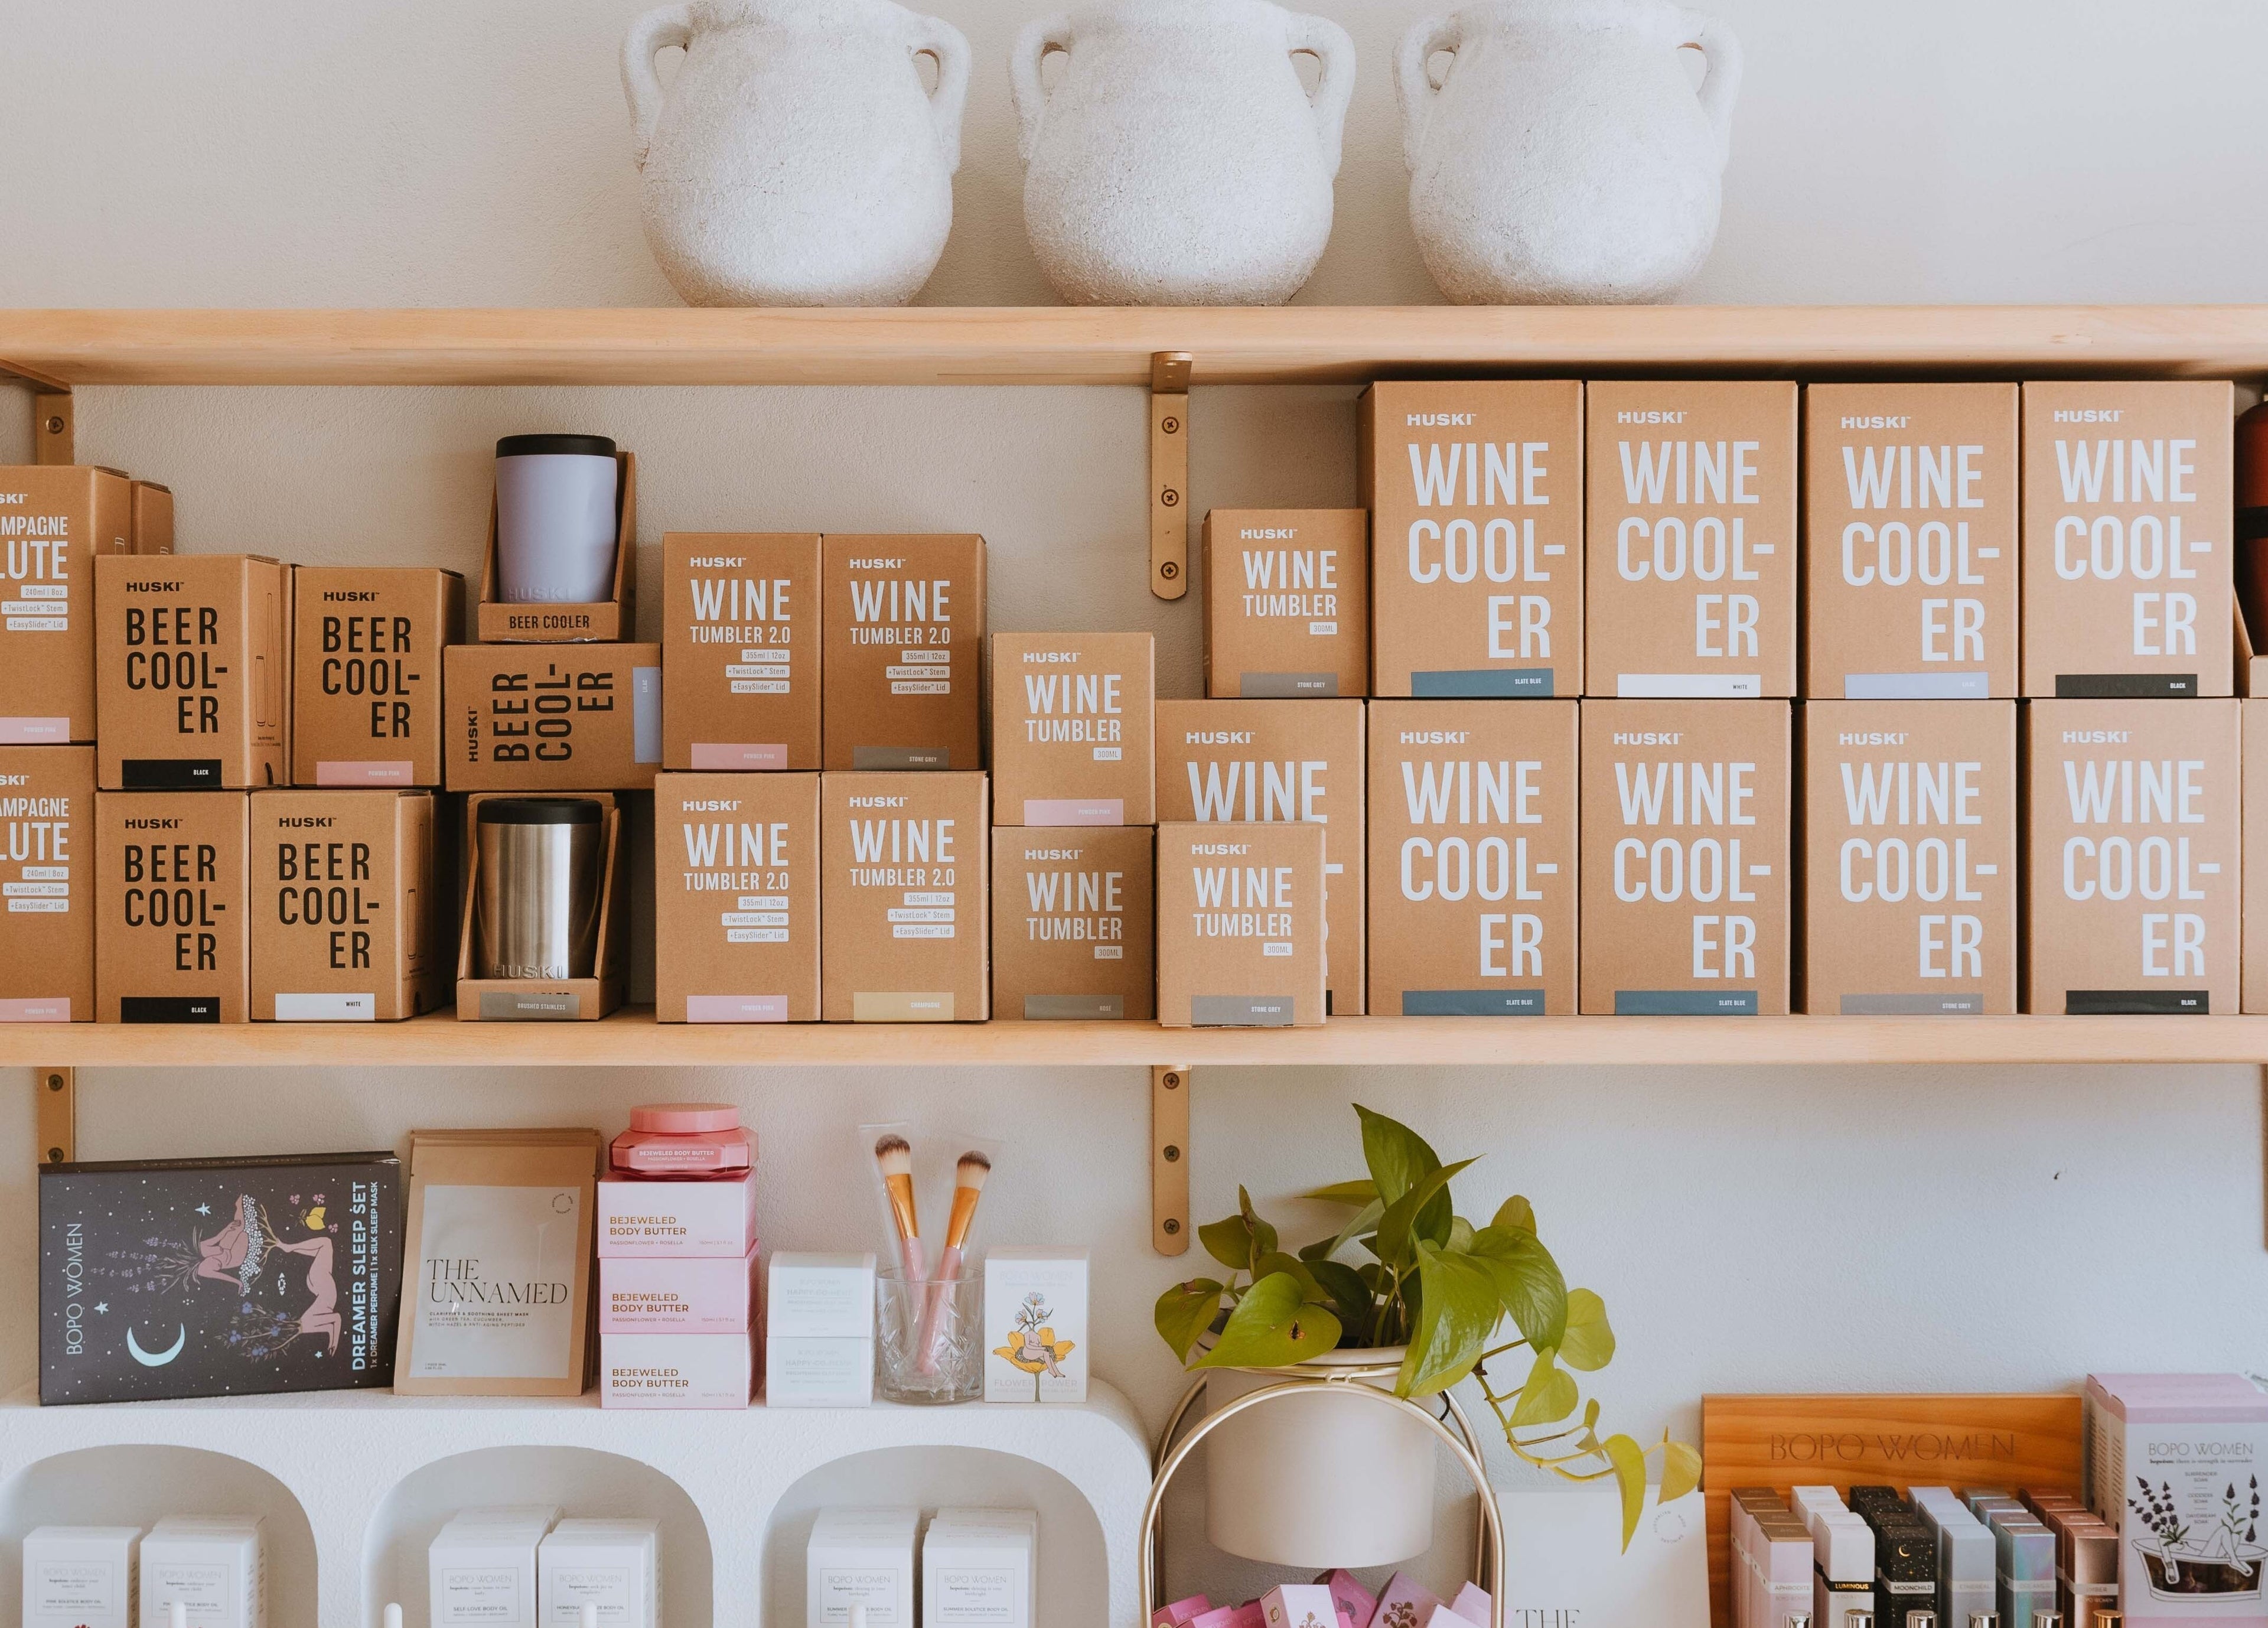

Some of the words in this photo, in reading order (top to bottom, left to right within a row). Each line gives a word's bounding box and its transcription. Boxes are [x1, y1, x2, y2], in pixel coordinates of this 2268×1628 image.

[1409, 442, 1549, 506] WINE
[1619, 441, 1759, 503] WINE
[1843, 445, 1983, 509] WINE
[2055, 439, 2196, 502] WINE
[0, 516, 67, 535] MPAGNE
[0, 541, 68, 579] UTE
[1409, 519, 1565, 583] COOL-
[1618, 517, 1774, 581] COOL-
[1843, 522, 1999, 586] COOL-
[2055, 515, 2211, 579] COOL-
[1243, 550, 1337, 589] WINE
[691, 579, 790, 620] WINE
[850, 581, 950, 621] WINE
[1243, 595, 1336, 616] TUMBLER
[126, 608, 217, 645] BEER
[323, 617, 410, 652] BEER
[510, 616, 538, 629] BEER
[543, 616, 589, 629] COOLER
[690, 626, 762, 643] TUMBLER
[770, 627, 790, 643] 2.0
[850, 628, 922, 644] TUMBLER
[930, 627, 950, 644] 2.0
[1488, 595, 1550, 658] ER
[1696, 594, 1759, 656] ER
[1922, 599, 1984, 661] ER
[2134, 592, 2197, 655] ER
[127, 652, 227, 689] COOL-
[323, 659, 419, 695] COOL-
[578, 673, 613, 711] ER
[1025, 675, 1121, 714] WINE
[178, 696, 218, 733] ER
[372, 702, 410, 737] ER
[493, 674, 529, 761] BEER
[535, 664, 572, 761] COOL-
[1025, 719, 1120, 742] TUMBLER
[1187, 761, 1327, 823] WINE
[1402, 761, 1542, 823] WINE
[1615, 763, 1755, 825] WINE
[1840, 762, 1981, 825] WINE
[2064, 761, 2204, 823] WINE
[684, 823, 788, 867] WINE
[850, 820, 954, 862] WINE
[125, 845, 216, 882] BEER
[279, 844, 369, 880] BEER
[684, 872, 760, 890] TUMBLER
[767, 872, 788, 890] 2.0
[850, 869, 925, 887] TUMBLER
[933, 868, 954, 885] 2.0
[1402, 837, 1557, 901] COOL-
[1615, 838, 1771, 902] COOL-
[1841, 838, 1997, 902] COOL-
[2064, 836, 2220, 900] COOL-
[125, 888, 225, 926] COOL-
[279, 887, 379, 924] COOL-
[1027, 872, 1122, 911] WINE
[1194, 868, 1292, 907] WINE
[1027, 917, 1122, 940] TUMBLER
[1193, 914, 1291, 936] TUMBLER
[2143, 914, 2205, 976] ER
[176, 933, 216, 970] ER
[330, 932, 370, 968] ER
[1481, 914, 1543, 977] ER
[1693, 916, 1755, 978] ER
[1920, 915, 1982, 977] ER
[493, 964, 563, 979] HUSKI
[353, 1182, 366, 1214] SET
[67, 1223, 83, 1298] WOMEN
[353, 1220, 366, 1275] SLEEP
[426, 1259, 479, 1280] THE
[431, 1282, 567, 1304] UNNAMED
[67, 1303, 83, 1355] BOPO
[353, 1282, 366, 1370] DREAMER
[1772, 1434, 1864, 1461] BOPO
[1878, 1434, 2015, 1461] WOMEN
[2149, 1443, 2189, 1456] BOPO
[2195, 1443, 2253, 1456] WOMEN
